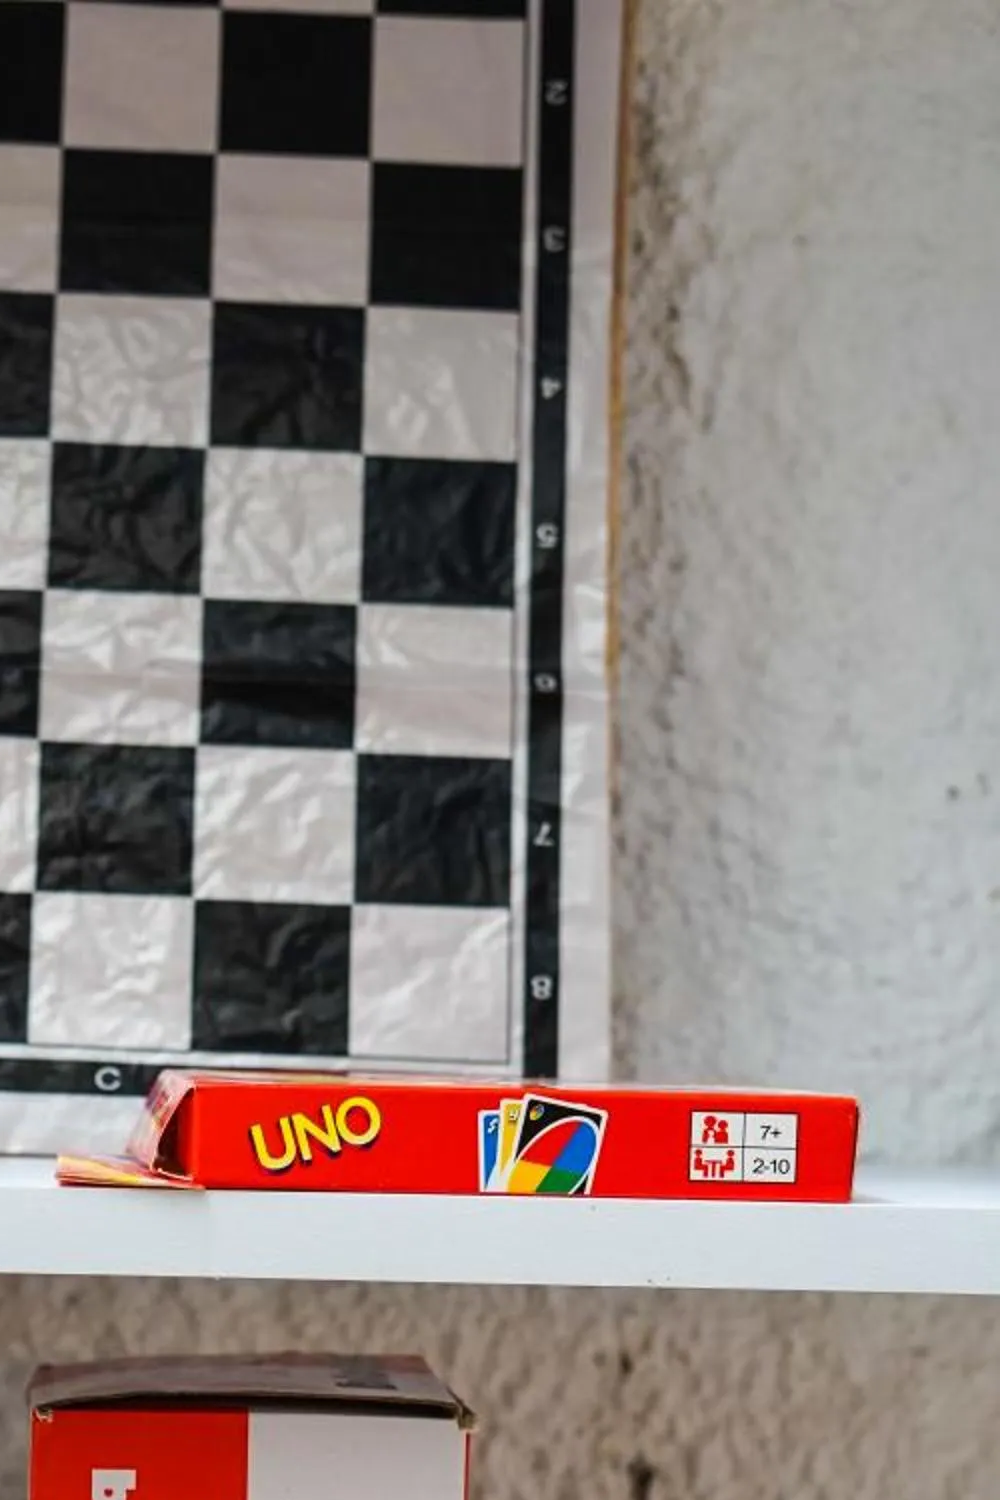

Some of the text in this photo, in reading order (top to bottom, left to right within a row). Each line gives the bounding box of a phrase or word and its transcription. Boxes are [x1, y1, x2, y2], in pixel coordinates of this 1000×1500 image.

[95, 1067, 120, 1090] C
[250, 1096, 381, 1172] UNO
[760, 1125, 782, 1141] 7+
[752, 1158, 791, 1176] 2-10
